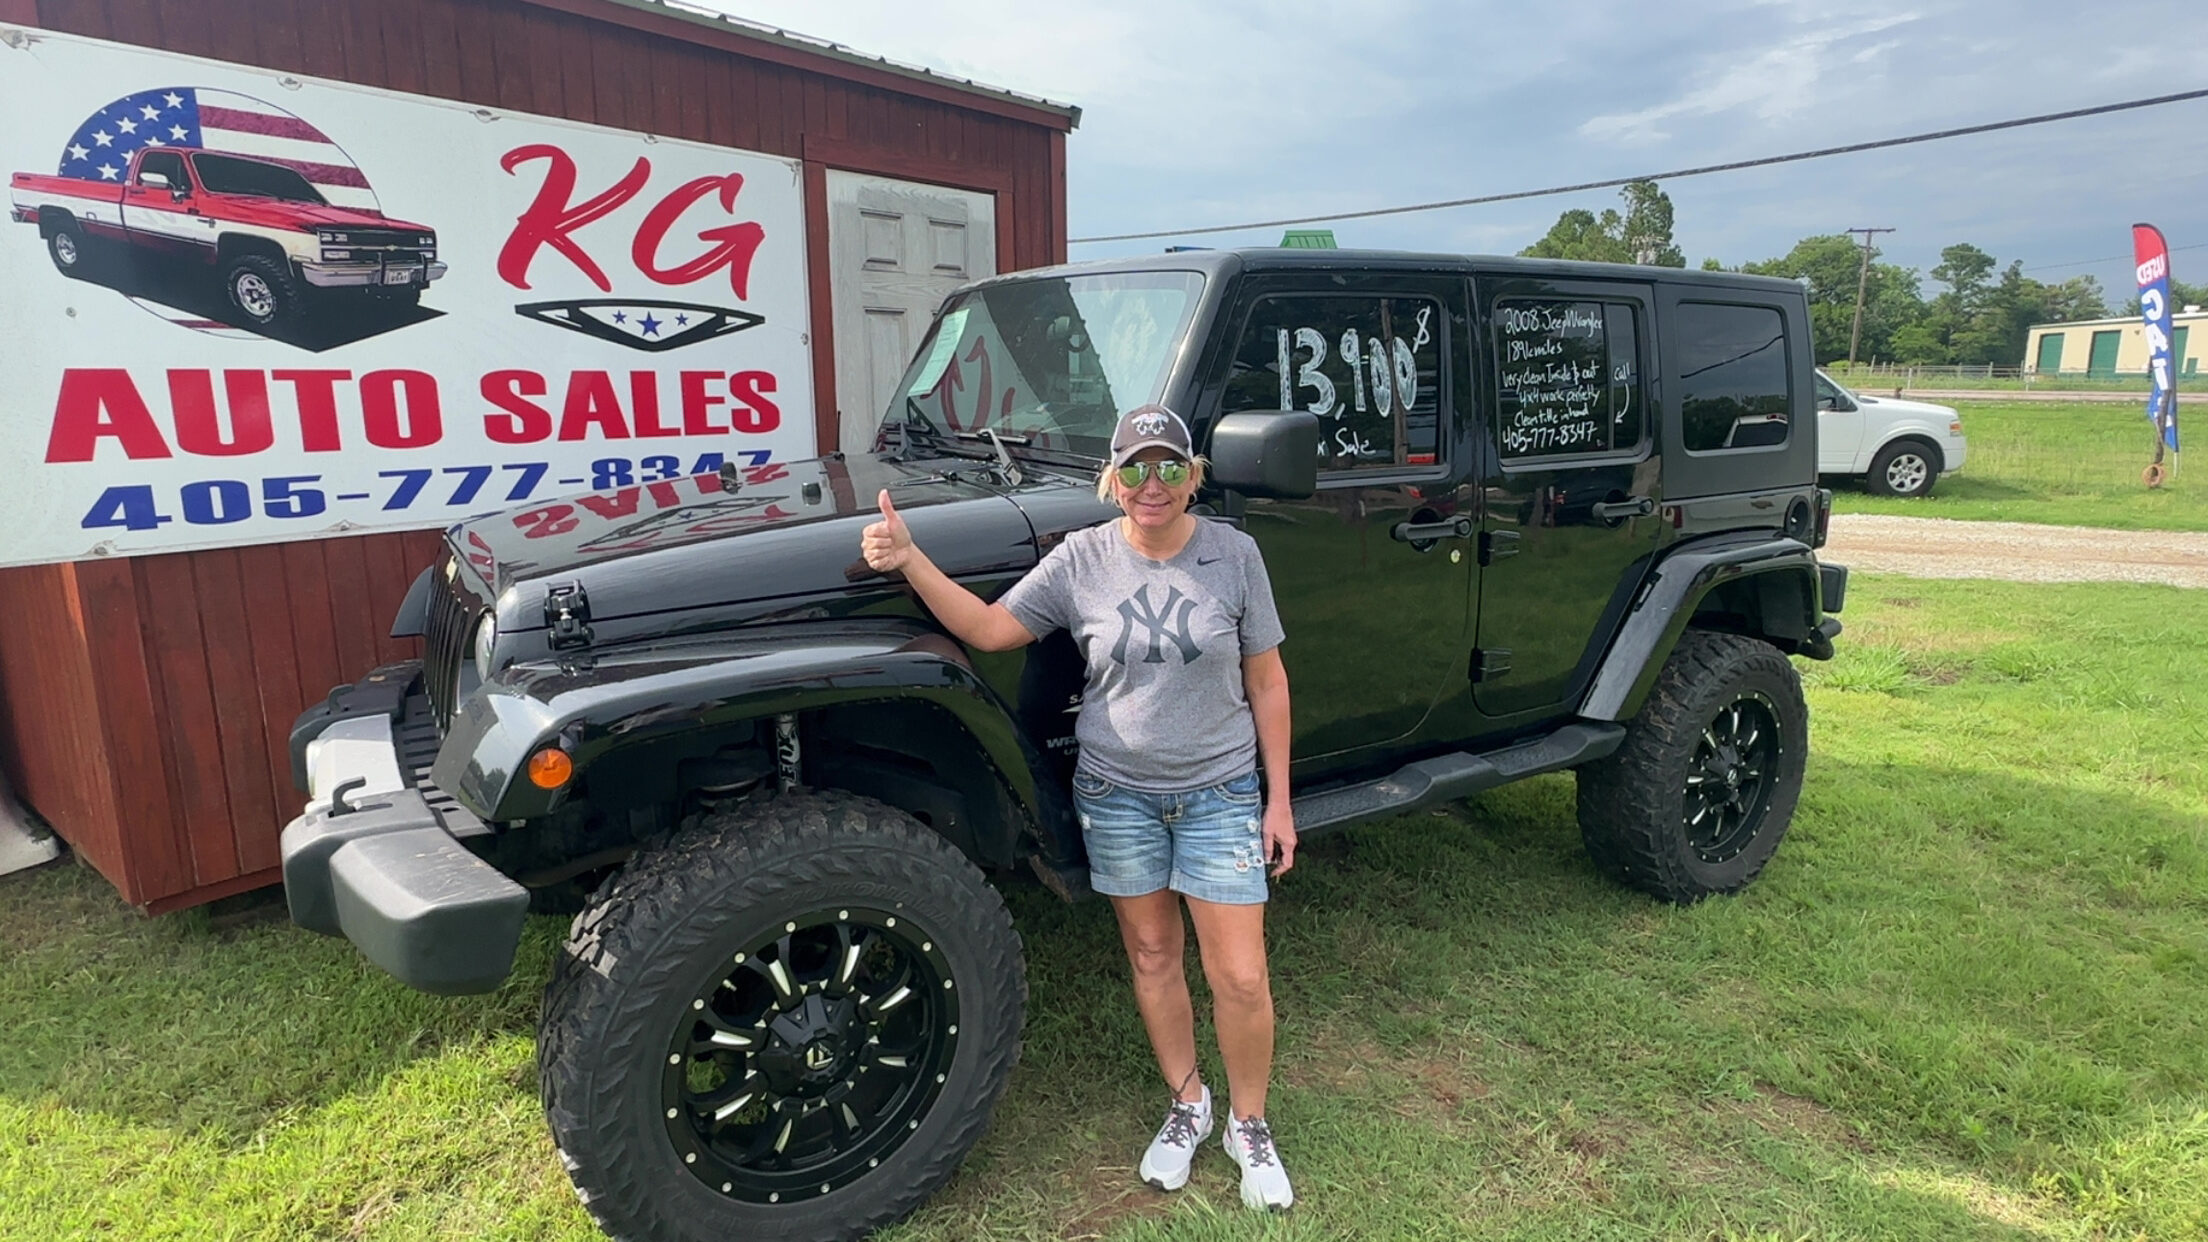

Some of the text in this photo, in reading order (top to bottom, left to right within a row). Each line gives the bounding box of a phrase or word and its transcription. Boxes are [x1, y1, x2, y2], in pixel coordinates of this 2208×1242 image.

[498, 144, 766, 301] KG
[1504, 308, 1540, 335] 2008
[1541, 308, 1566, 338] Jeep
[44, 368, 781, 464] AUTO SALES
[1335, 427, 1376, 457] Sale
[1502, 420, 1598, 452] 405-777-8347
